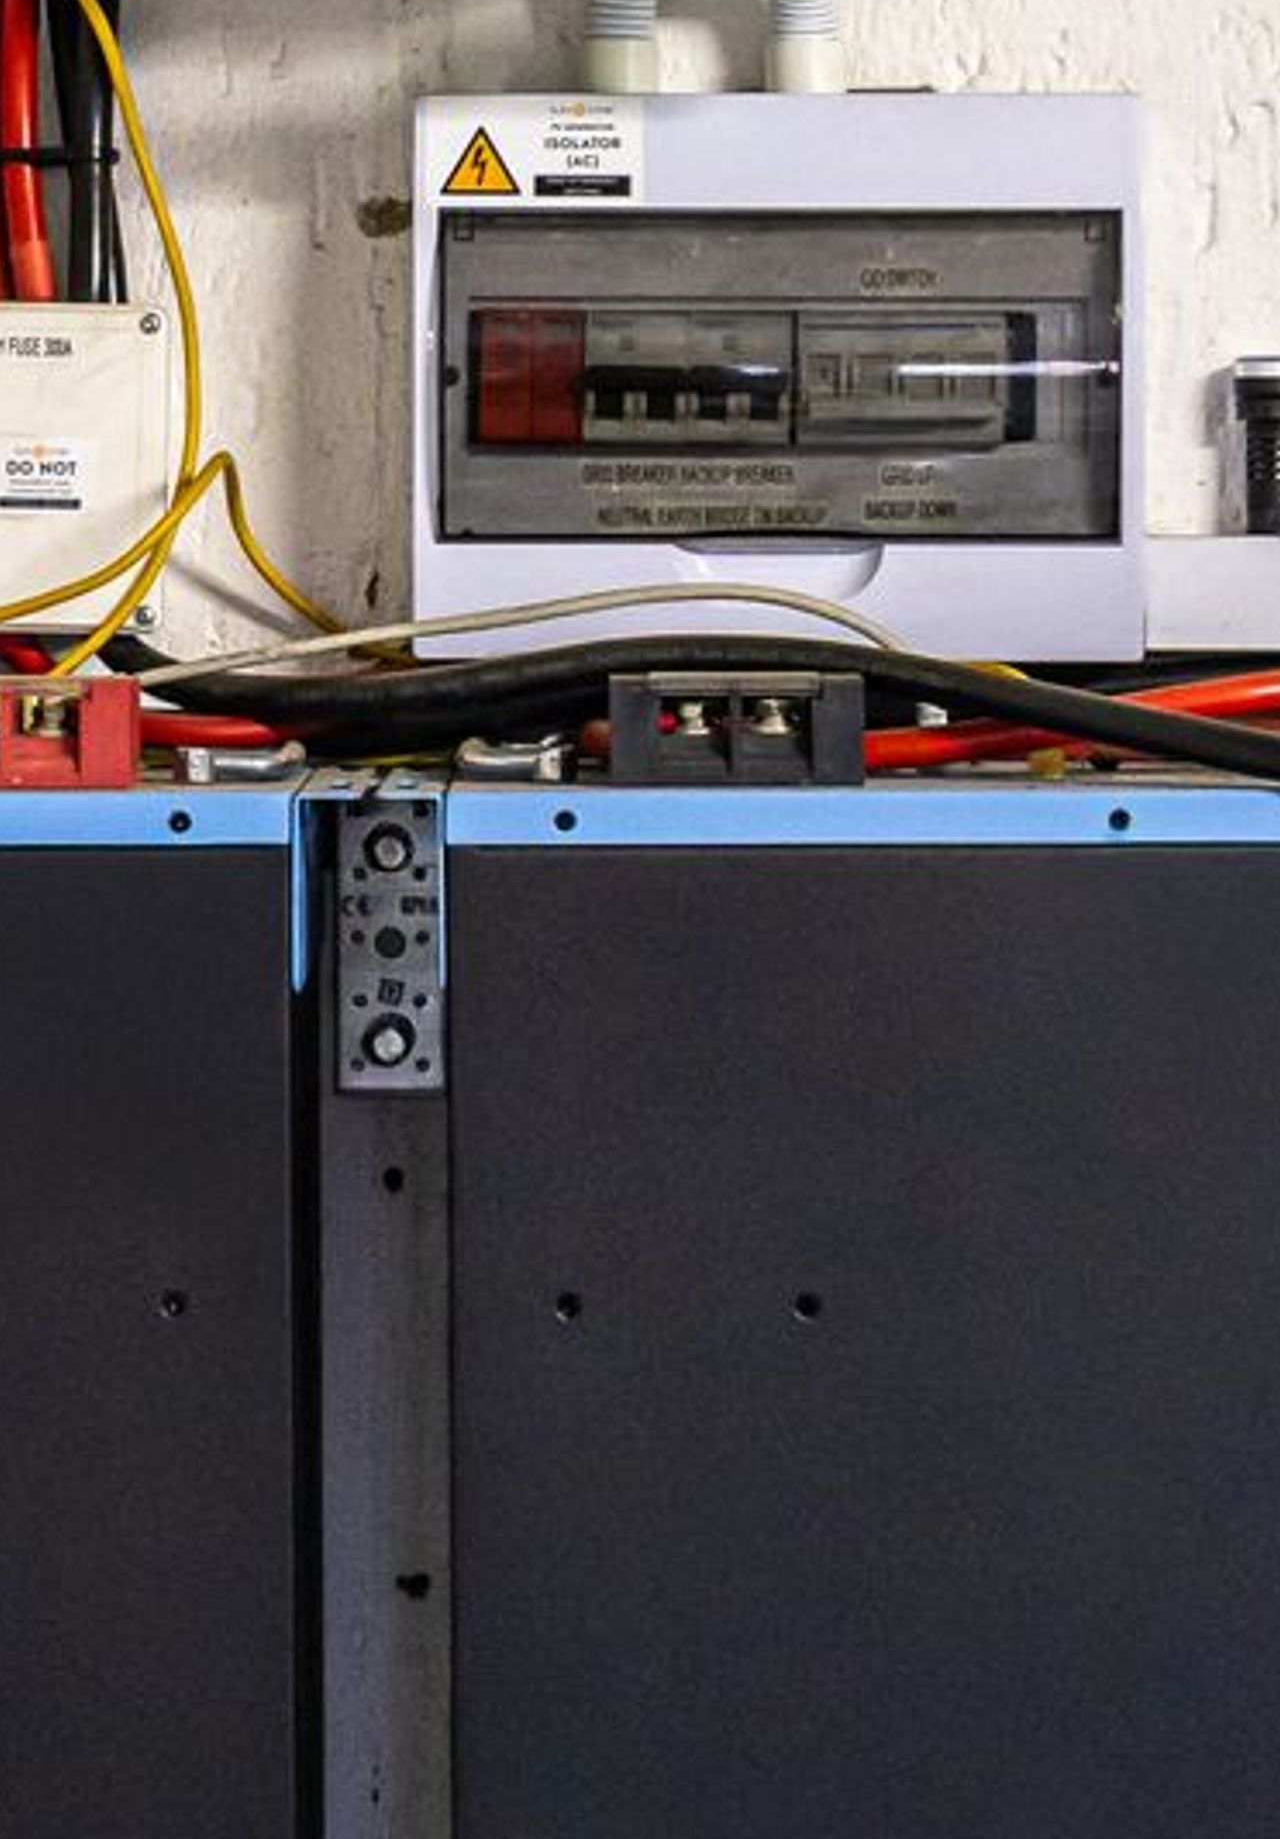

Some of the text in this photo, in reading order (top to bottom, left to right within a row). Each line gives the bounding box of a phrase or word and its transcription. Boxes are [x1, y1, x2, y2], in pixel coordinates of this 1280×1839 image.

[543, 136, 621, 150] ISOLATOR
[8, 336, 41, 357] FUSE
[5, 460, 77, 476] DO NOT
[616, 465, 675, 484] BREAKER
